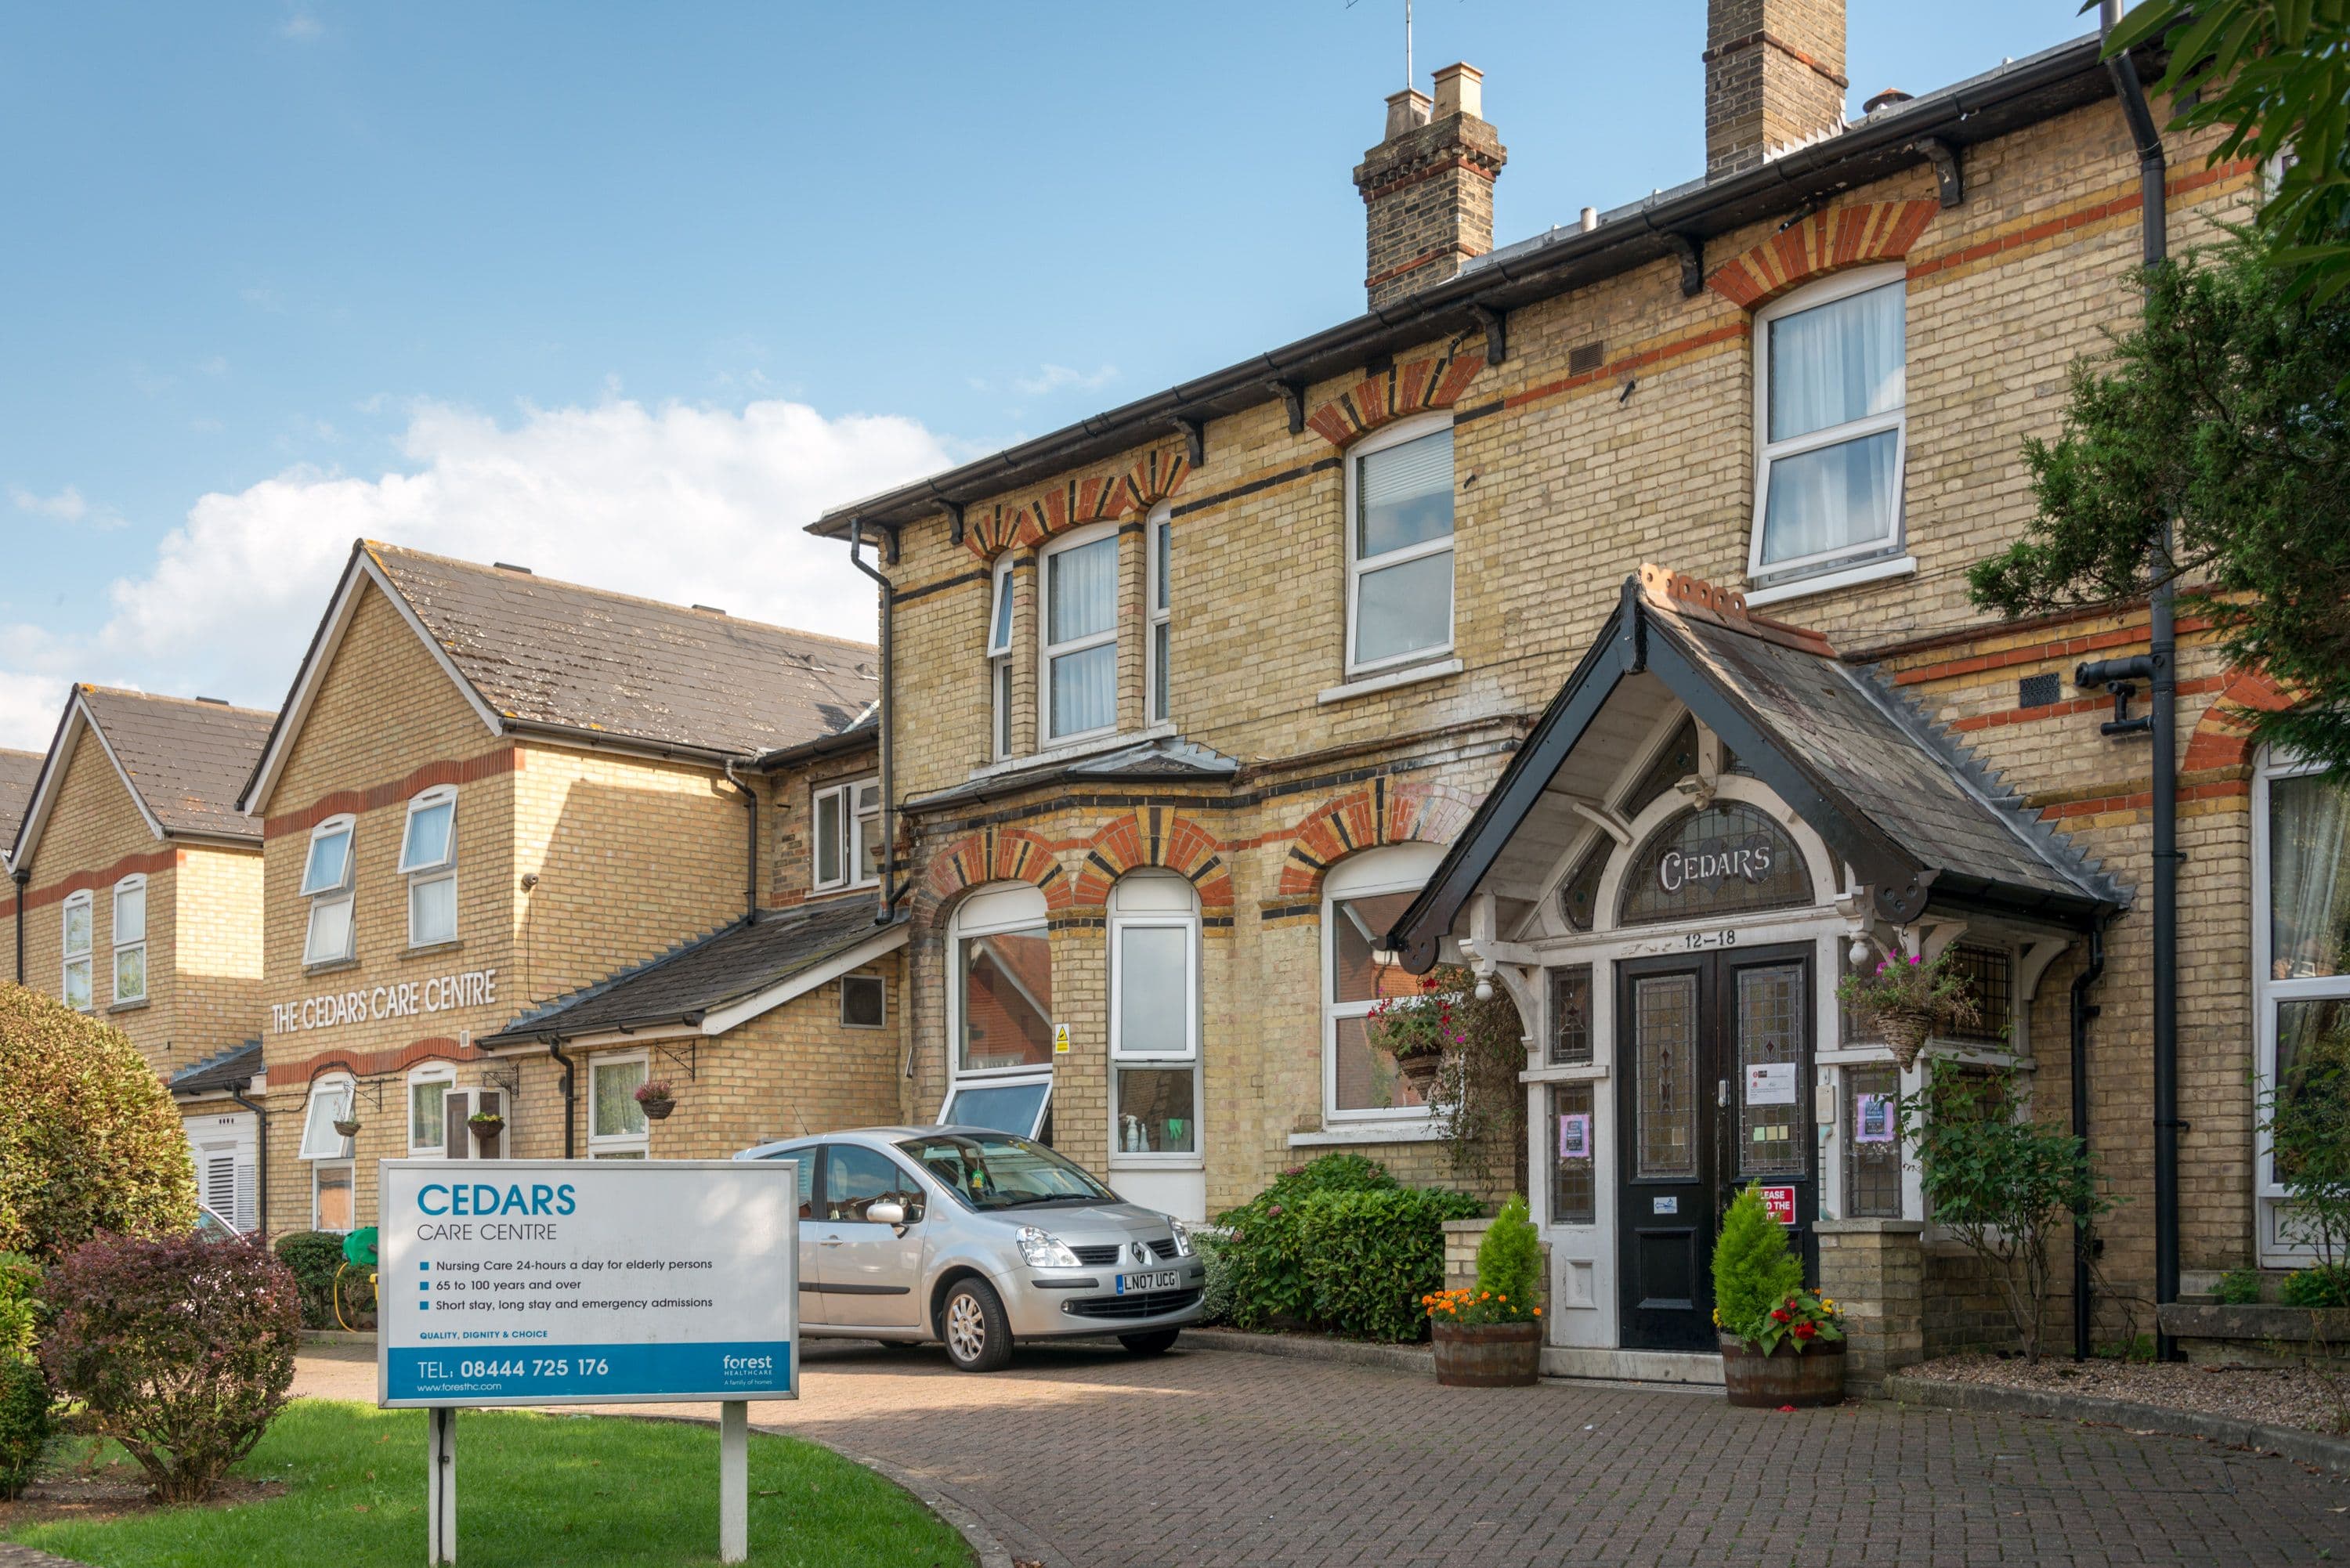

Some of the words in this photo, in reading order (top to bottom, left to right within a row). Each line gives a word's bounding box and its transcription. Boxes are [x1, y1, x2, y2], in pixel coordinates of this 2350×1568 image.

[1661, 846, 1770, 891] CEDARS
[272, 1001, 298, 1034] THE
[302, 989, 367, 1030] CEDARS
[371, 981, 419, 1020] CARE
[425, 969, 496, 1013] CENTRE
[418, 1184, 577, 1216] CEDARS
[1773, 1201, 1791, 1210] THE
[417, 1224, 472, 1241] CARE
[480, 1223, 557, 1241] CENTRE
[436, 1260, 479, 1273] Nursing
[483, 1260, 513, 1270] Care
[516, 1260, 566, 1270] 24-hours
[581, 1259, 604, 1272] day
[607, 1259, 623, 1270] for
[626, 1259, 665, 1271] elderly
[668, 1260, 713, 1271] persons
[436, 1281, 450, 1291] 65
[454, 1281, 466, 1291] to
[471, 1281, 490, 1290] 100
[494, 1281, 525, 1292] years
[529, 1280, 551, 1290] and
[1124, 1274, 1153, 1290] LN07
[1156, 1272, 1175, 1287] UCG
[436, 1300, 465, 1310] Short
[468, 1300, 496, 1312] stay,
[498, 1299, 525, 1312] long
[528, 1299, 551, 1311] stay
[555, 1299, 578, 1309] and
[582, 1300, 648, 1310] emergency
[651, 1297, 713, 1308] admissions
[420, 1331, 461, 1340] QUALITY,
[461, 1360, 525, 1378] 08444
[532, 1359, 569, 1376] 725
[578, 1358, 609, 1375] 176
[723, 1354, 772, 1369] forest
[417, 1382, 502, 1392] www.foresthc.com
